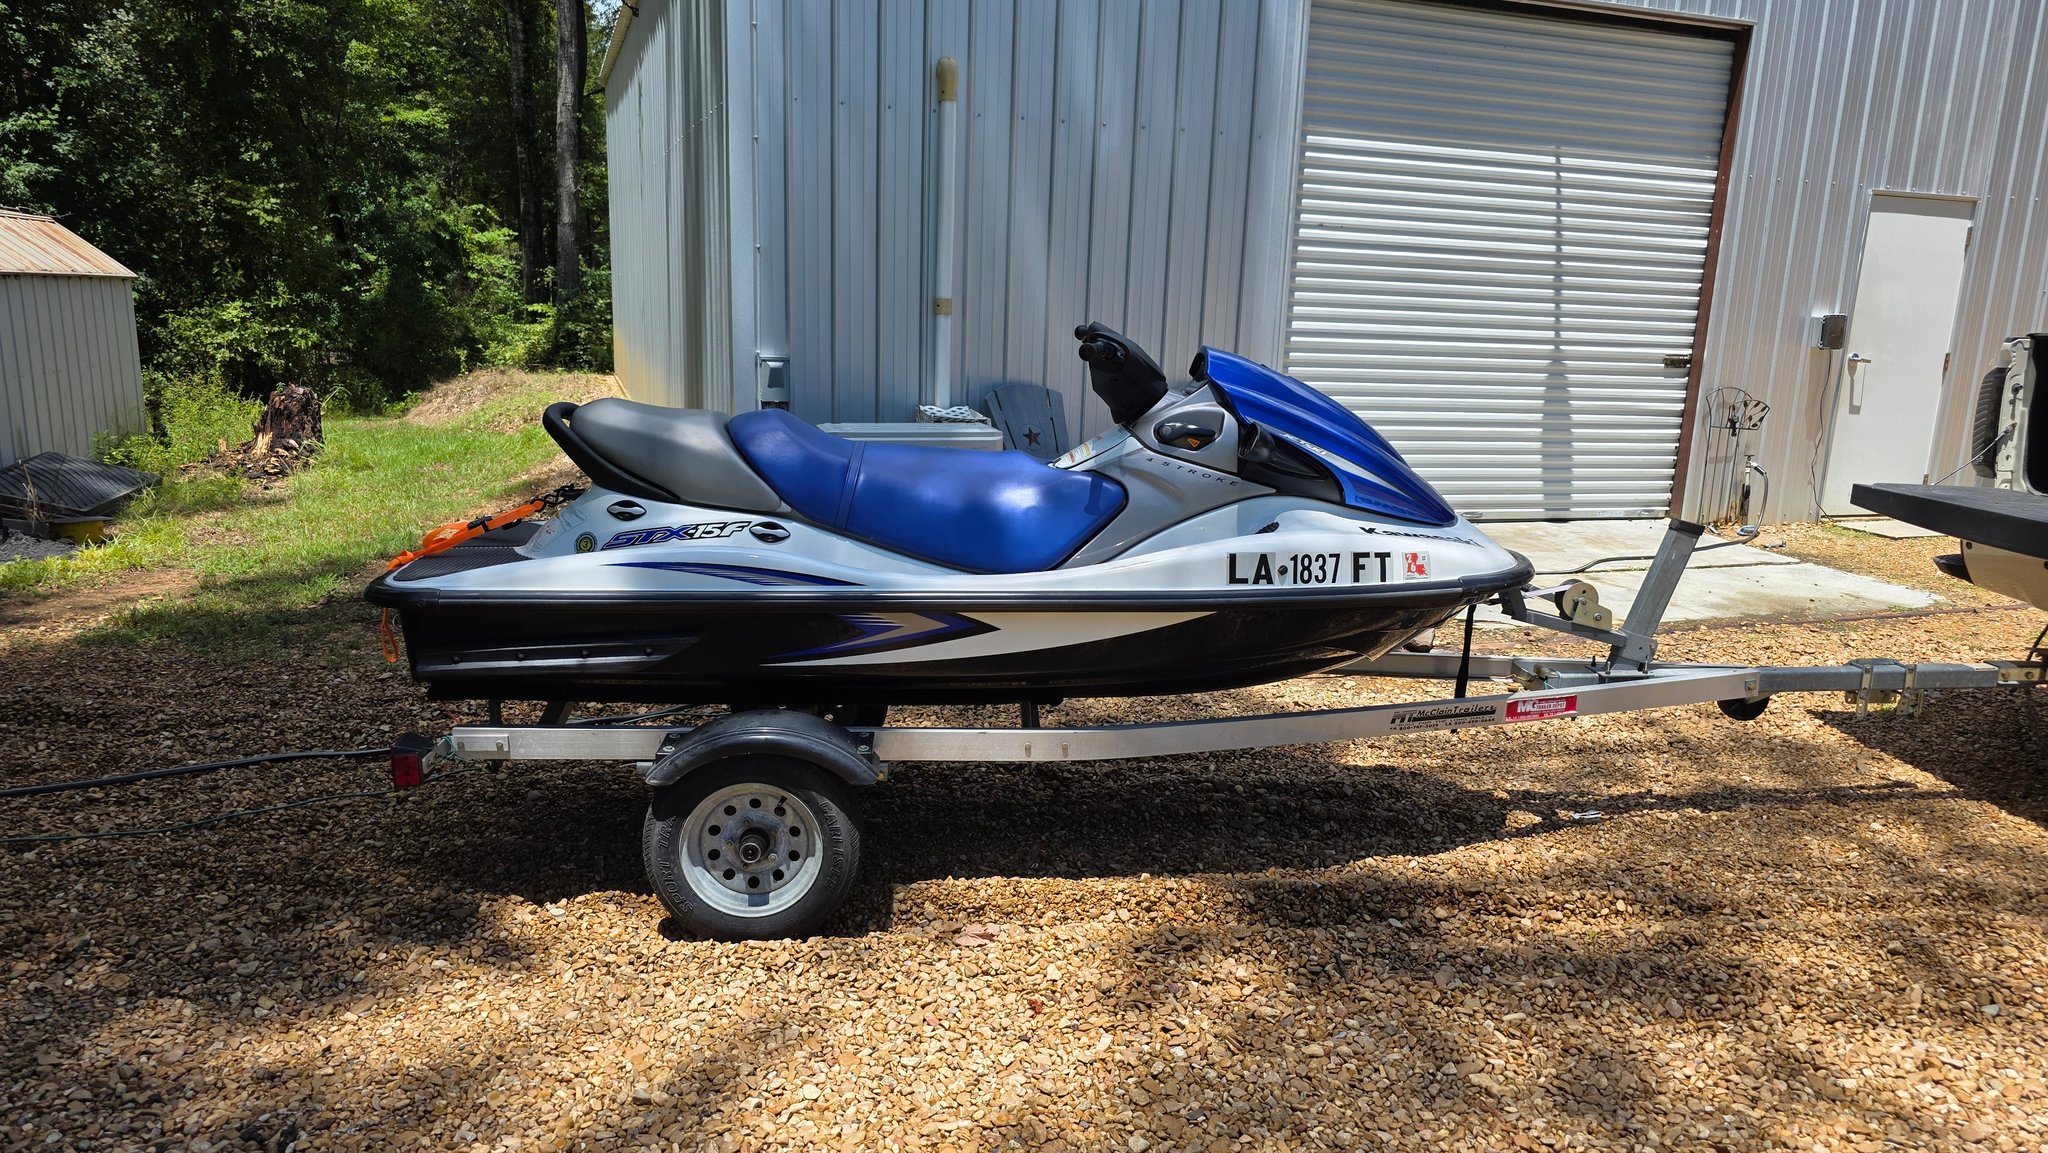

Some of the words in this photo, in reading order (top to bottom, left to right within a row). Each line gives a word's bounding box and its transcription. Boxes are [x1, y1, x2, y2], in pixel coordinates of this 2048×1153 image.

[1161, 462, 1239, 487] STROKE
[1229, 553, 1274, 585] LA
[1290, 553, 1341, 584] 1837
[1353, 552, 1391, 583] FT
